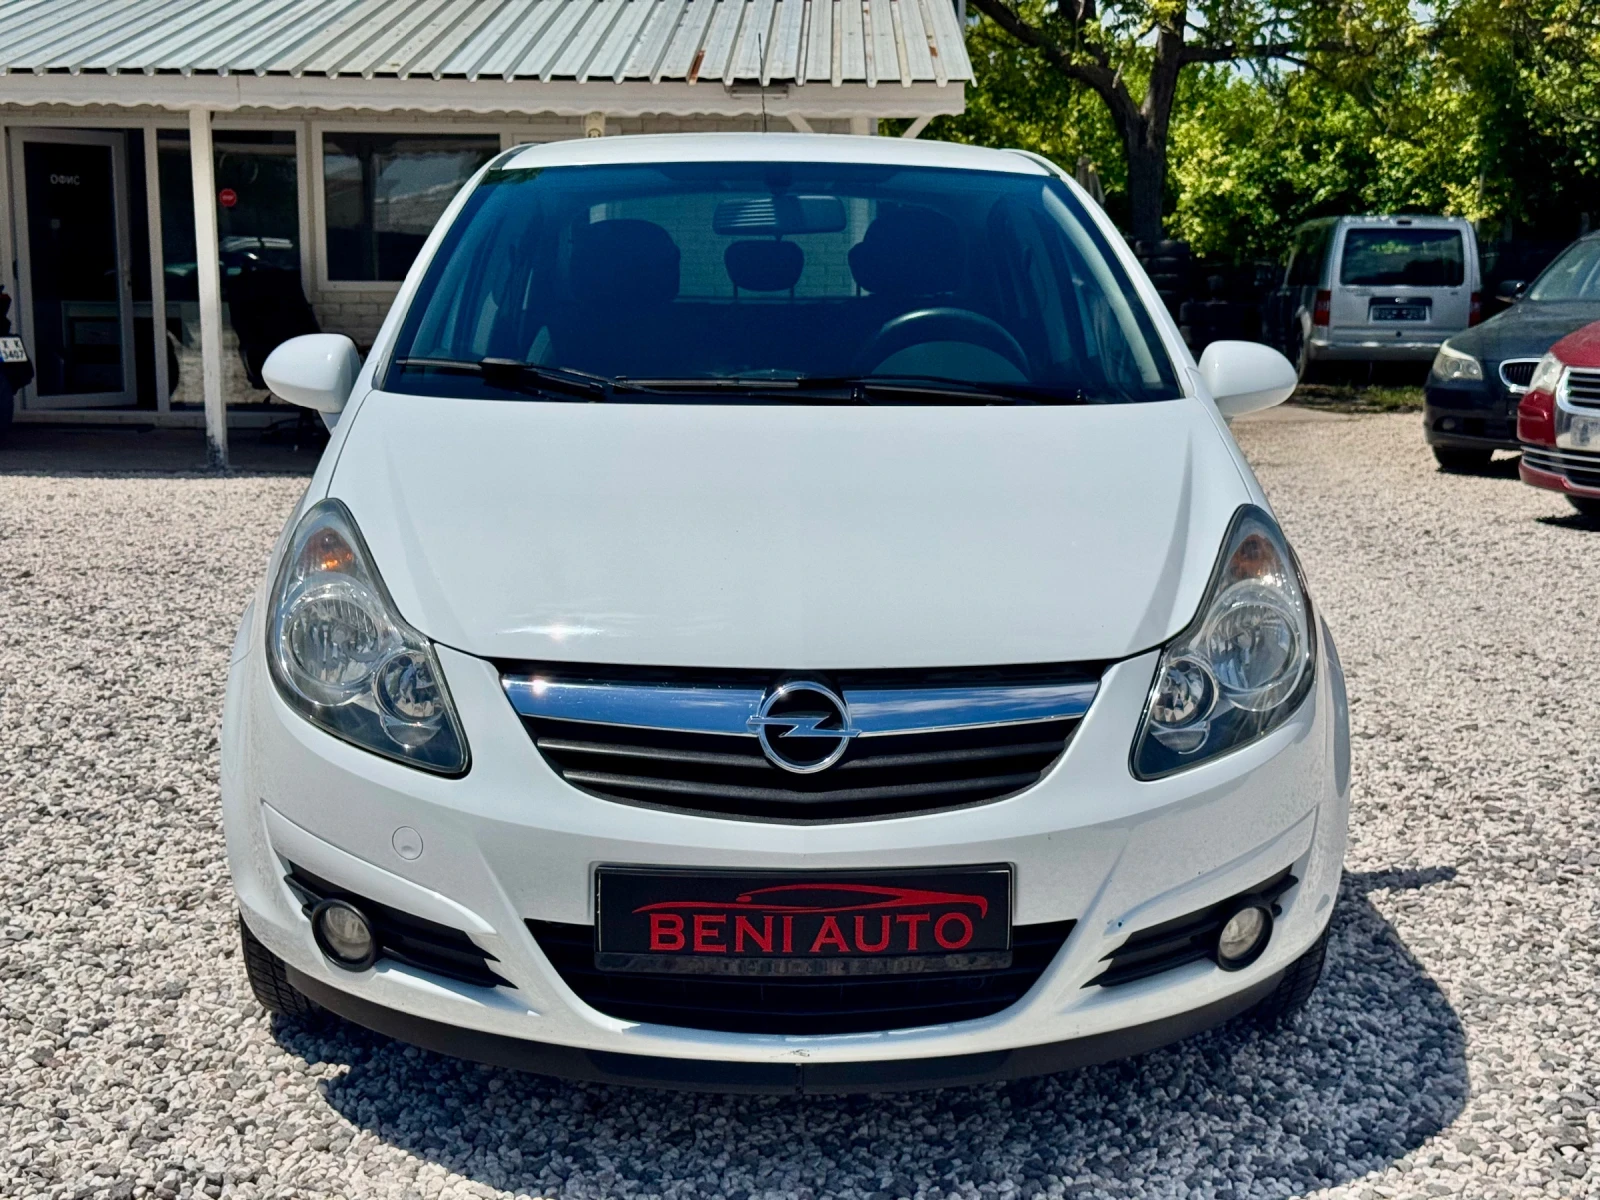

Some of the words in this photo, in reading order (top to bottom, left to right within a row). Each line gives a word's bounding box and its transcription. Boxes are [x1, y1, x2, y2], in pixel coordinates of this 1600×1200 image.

[50, 174, 80, 185] ОФИС
[649, 913, 793, 953] BENI
[809, 912, 973, 953] AUTO
